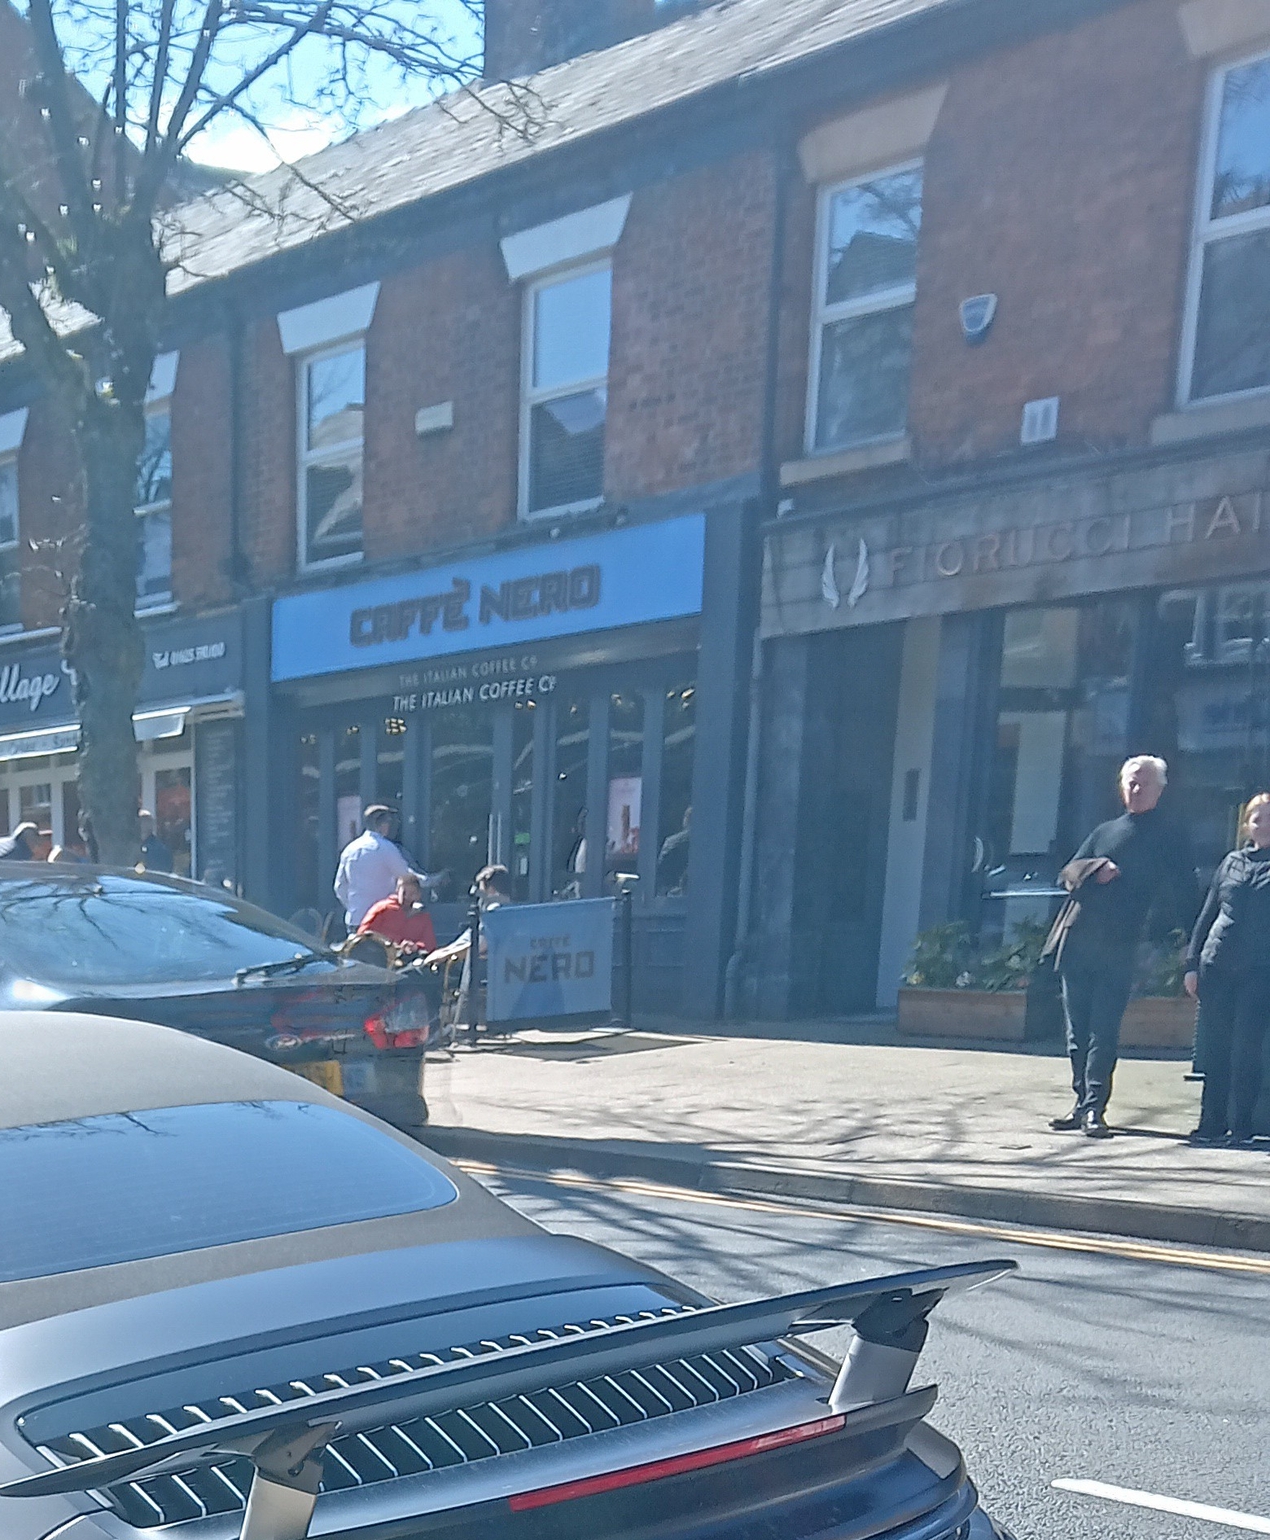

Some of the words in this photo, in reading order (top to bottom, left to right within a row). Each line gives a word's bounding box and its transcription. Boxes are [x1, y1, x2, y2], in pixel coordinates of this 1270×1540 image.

[890, 516, 1130, 588] FIORUCCI
[479, 564, 601, 625] NERO
[393, 693, 417, 712] THE
[422, 686, 474, 709] ITALIAN
[480, 677, 534, 700] COFFEE
[505, 951, 594, 983] NERO
